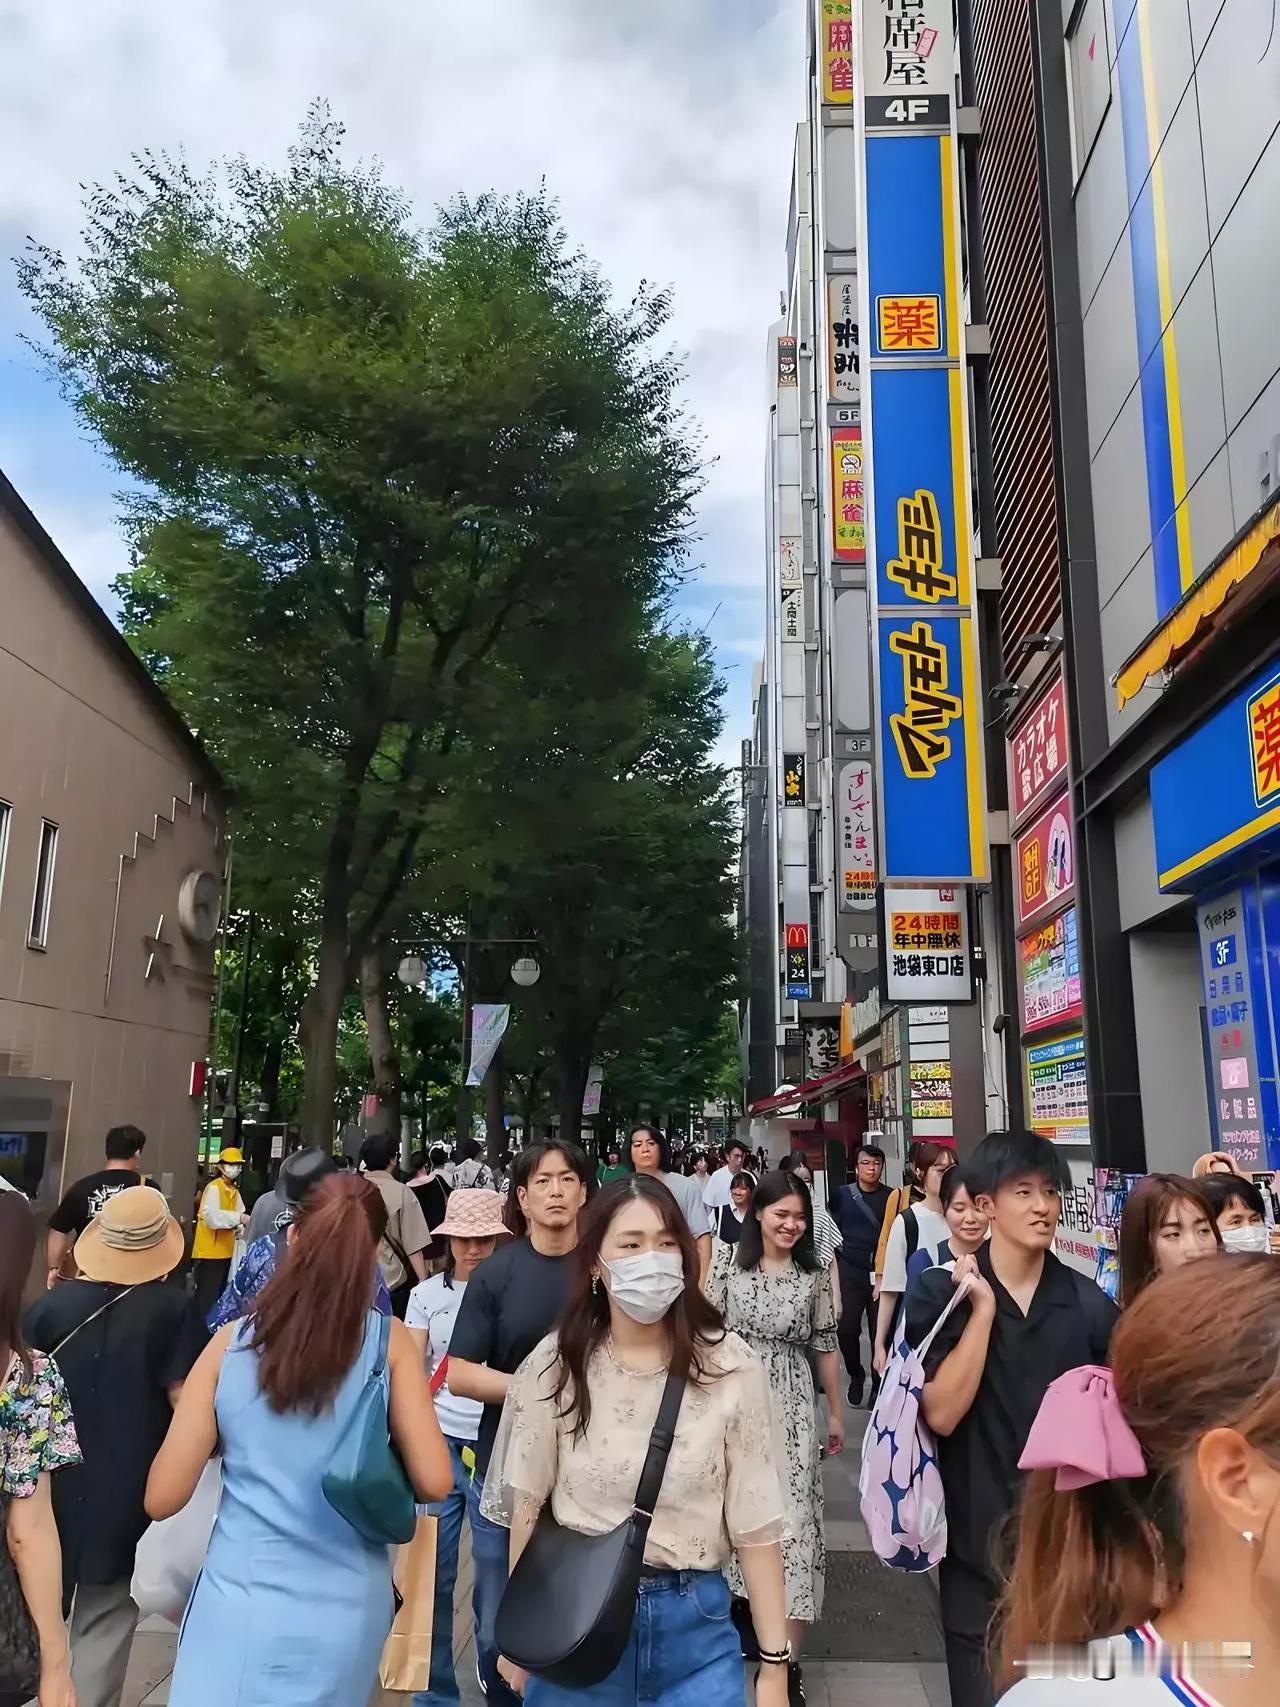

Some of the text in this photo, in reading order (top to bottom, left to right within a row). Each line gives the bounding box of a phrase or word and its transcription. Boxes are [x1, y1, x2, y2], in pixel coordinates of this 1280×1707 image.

[885, 99, 930, 122] 4F
[884, 300, 935, 346] 薬
[852, 739, 866, 751] 3F
[1017, 698, 1059, 774] カラオケ
[894, 915, 960, 931] 24時間
[894, 932, 961, 949] 年中無休
[1216, 940, 1230, 965] 3F
[791, 968, 805, 978] 24
[893, 954, 964, 977] 池袋東口店
